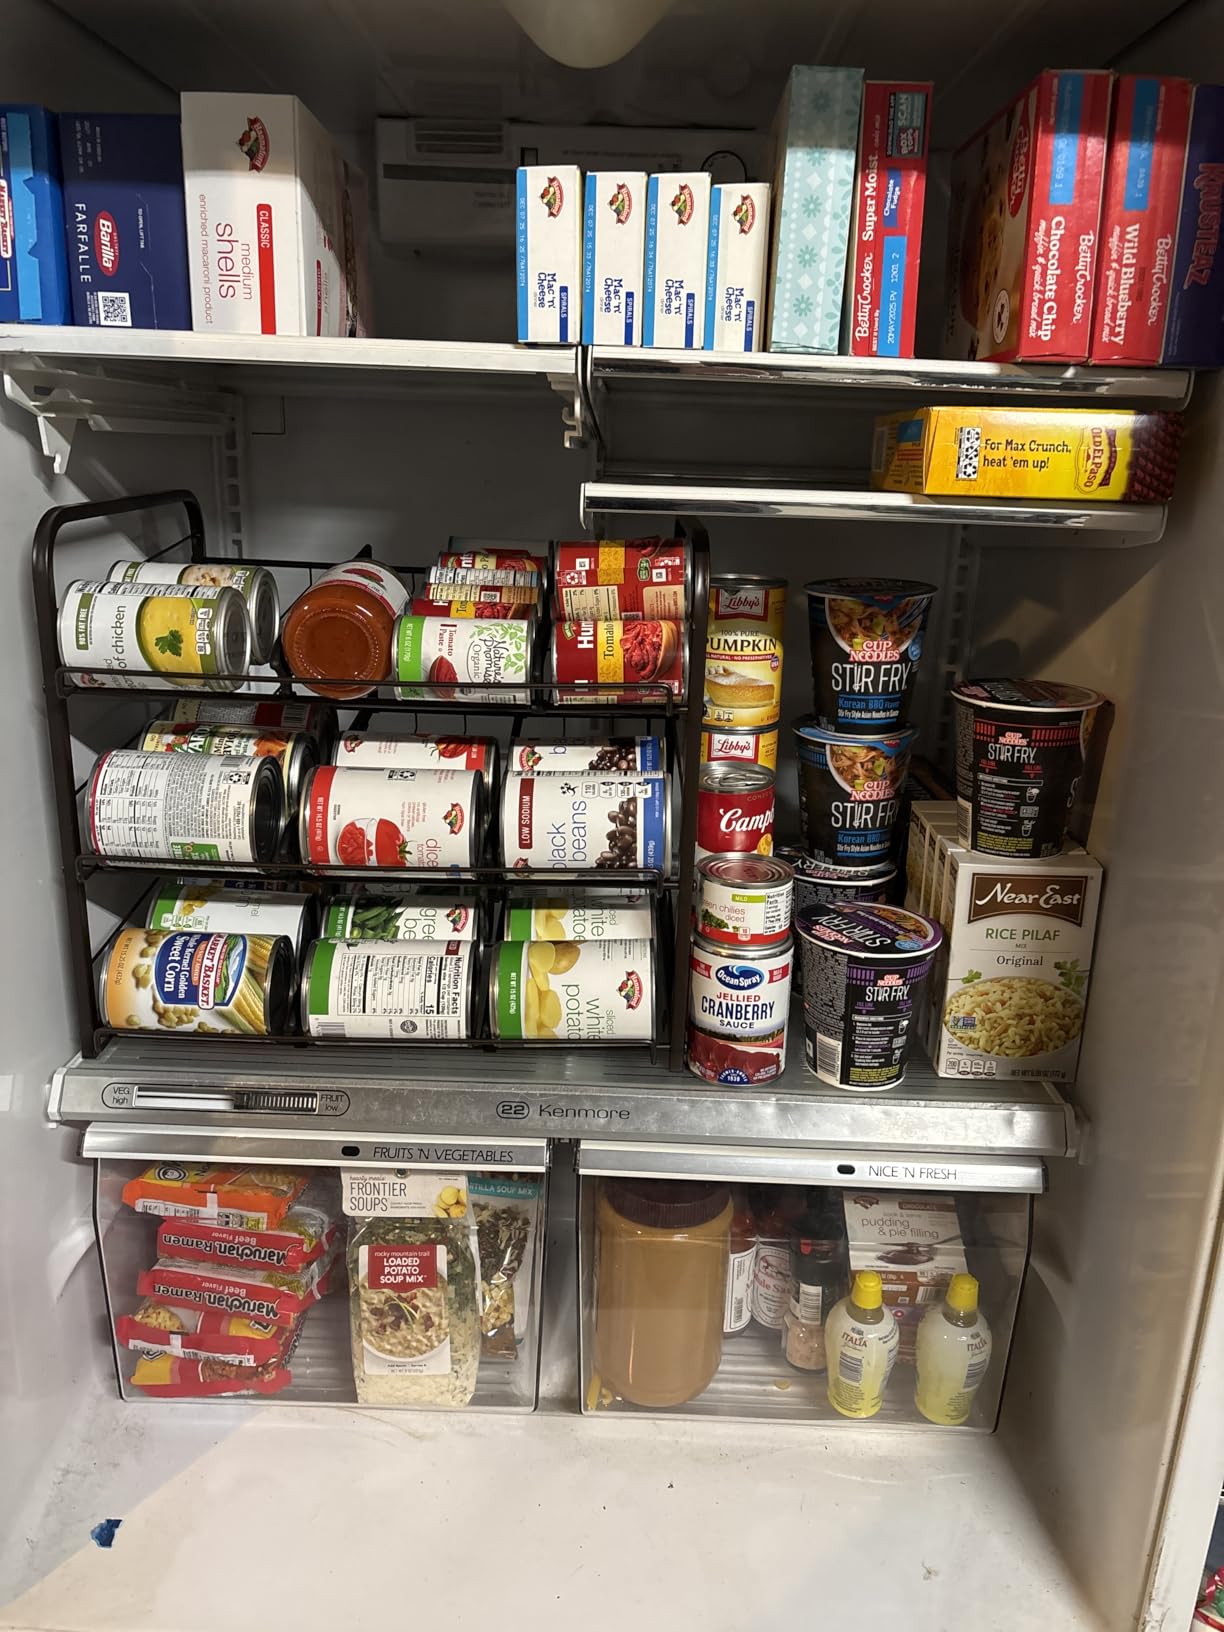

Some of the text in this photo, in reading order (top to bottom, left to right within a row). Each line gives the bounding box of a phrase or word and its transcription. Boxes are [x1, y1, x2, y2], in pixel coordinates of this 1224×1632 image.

[897, 94, 907, 127] SCAN
[253, 121, 270, 169] Hannaford
[900, 133, 908, 154] BOX
[906, 128, 914, 151] TOPS
[884, 179, 895, 216] Chocolate
[891, 185, 901, 209] Fudge
[259, 210, 271, 249] CLASSIC
[1183, 162, 1224, 290] KRUSTEAZ
[75, 203, 92, 284] FARFALLE
[99, 218, 114, 271] Barilla
[855, 153, 879, 341] Betty Crocker Super Moist
[198, 193, 214, 324] enriched macaroni product
[215, 222, 241, 300] shells
[241, 243, 254, 300] medium
[1028, 219, 1047, 338] muffin quick bread mix
[1038, 215, 1065, 341] Chocolate Chip
[1072, 230, 1094, 324] Betty Crocker
[1147, 234, 1172, 326] Betty Crocker
[538, 272, 547, 308] Cheese
[547, 273, 556, 295] Mac
[604, 277, 613, 313] Cheese
[613, 278, 623, 300] Mac
[674, 280, 684, 302] Mac
[1101, 225, 1122, 344] muffin quick bread mix
[1111, 223, 1140, 345] Wild Blueberry
[664, 279, 674, 315] Cheese
[724, 286, 734, 322] Cheese
[734, 287, 744, 309] Mac
[686, 299, 694, 325] SPIRALS
[745, 306, 753, 331] SPIRALS
[984, 439, 1002, 451] For
[1005, 440, 1026, 452] Max
[1091, 427, 1102, 447] OLD
[983, 455, 1007, 467] heat
[1031, 456, 1050, 471] up!
[721, 592, 760, 610] Libby's
[78, 608, 88, 632] FAT FREE
[111, 605, 127, 654] chicken
[437, 628, 447, 646] Paste
[447, 628, 457, 657] Tomato
[603, 624, 615, 660] Tomato
[739, 629, 761, 638] PURE
[849, 650, 900, 663] NOODLES
[862, 640, 893, 651] CUP
[115, 656, 128, 669] of
[471, 643, 483, 679] Organic
[492, 638, 510, 684] Nature's
[831, 661, 911, 693] STIR FRY
[838, 698, 884, 709] Korean BBQ
[717, 737, 751, 754] Libby's
[987, 743, 1038, 764] STIR FRY
[850, 789, 895, 801] NOODLES
[863, 780, 890, 791] CUP
[522, 795, 531, 843] LOW SODIUM
[831, 801, 874, 829] STIR
[567, 800, 588, 862] beans
[837, 833, 865, 843] Korean
[975, 882, 1081, 909] Near East
[718, 904, 746, 916] chilies
[725, 913, 745, 923] diced
[985, 927, 1061, 941] RICE PILAF
[163, 935, 189, 992] Sweet Corn
[180, 948, 194, 970] Kernel
[200, 933, 224, 1007] MARKET BASKET
[996, 955, 1044, 968] Original
[178, 971, 191, 999] Golden
[425, 956, 436, 1015] Calories 15
[451, 956, 463, 1015] Nutrition Facts
[717, 968, 739, 986] Ocean
[738, 973, 761, 987] Spray
[716, 991, 761, 1003] JELLIED
[865, 985, 911, 1002] STIR FRY
[701, 996, 775, 1021] CRANBERRY
[605, 1009, 616, 1035] sliced
[719, 1019, 755, 1029] SAUCE
[112, 1096, 128, 1106] high
[321, 1093, 344, 1103] FRUIT
[324, 1103, 339, 1112] low
[501, 1104, 630, 1120] 22 Kenmore
[373, 1146, 514, 1162] FRUITS VEGETABLES
[868, 1165, 957, 1180] NICE FRESH
[350, 1182, 407, 1197] FRONTIER
[496, 1186, 516, 1194] SOUP
[350, 1197, 388, 1212] SOUPS
[860, 1218, 910, 1230] pudding
[877, 1227, 940, 1240] & pie filling
[163, 1234, 213, 1251] Ramen
[211, 1232, 257, 1245] Beef Flavor
[383, 1257, 420, 1266] LOADED
[384, 1266, 420, 1275] POTATO
[201, 1282, 247, 1297] Beef Flavor
[380, 1275, 425, 1284] SOUP MIX
[153, 1283, 202, 1303] Ramen
[841, 1332, 868, 1348] ITALIA
[966, 1339, 988, 1352] ITALIA
